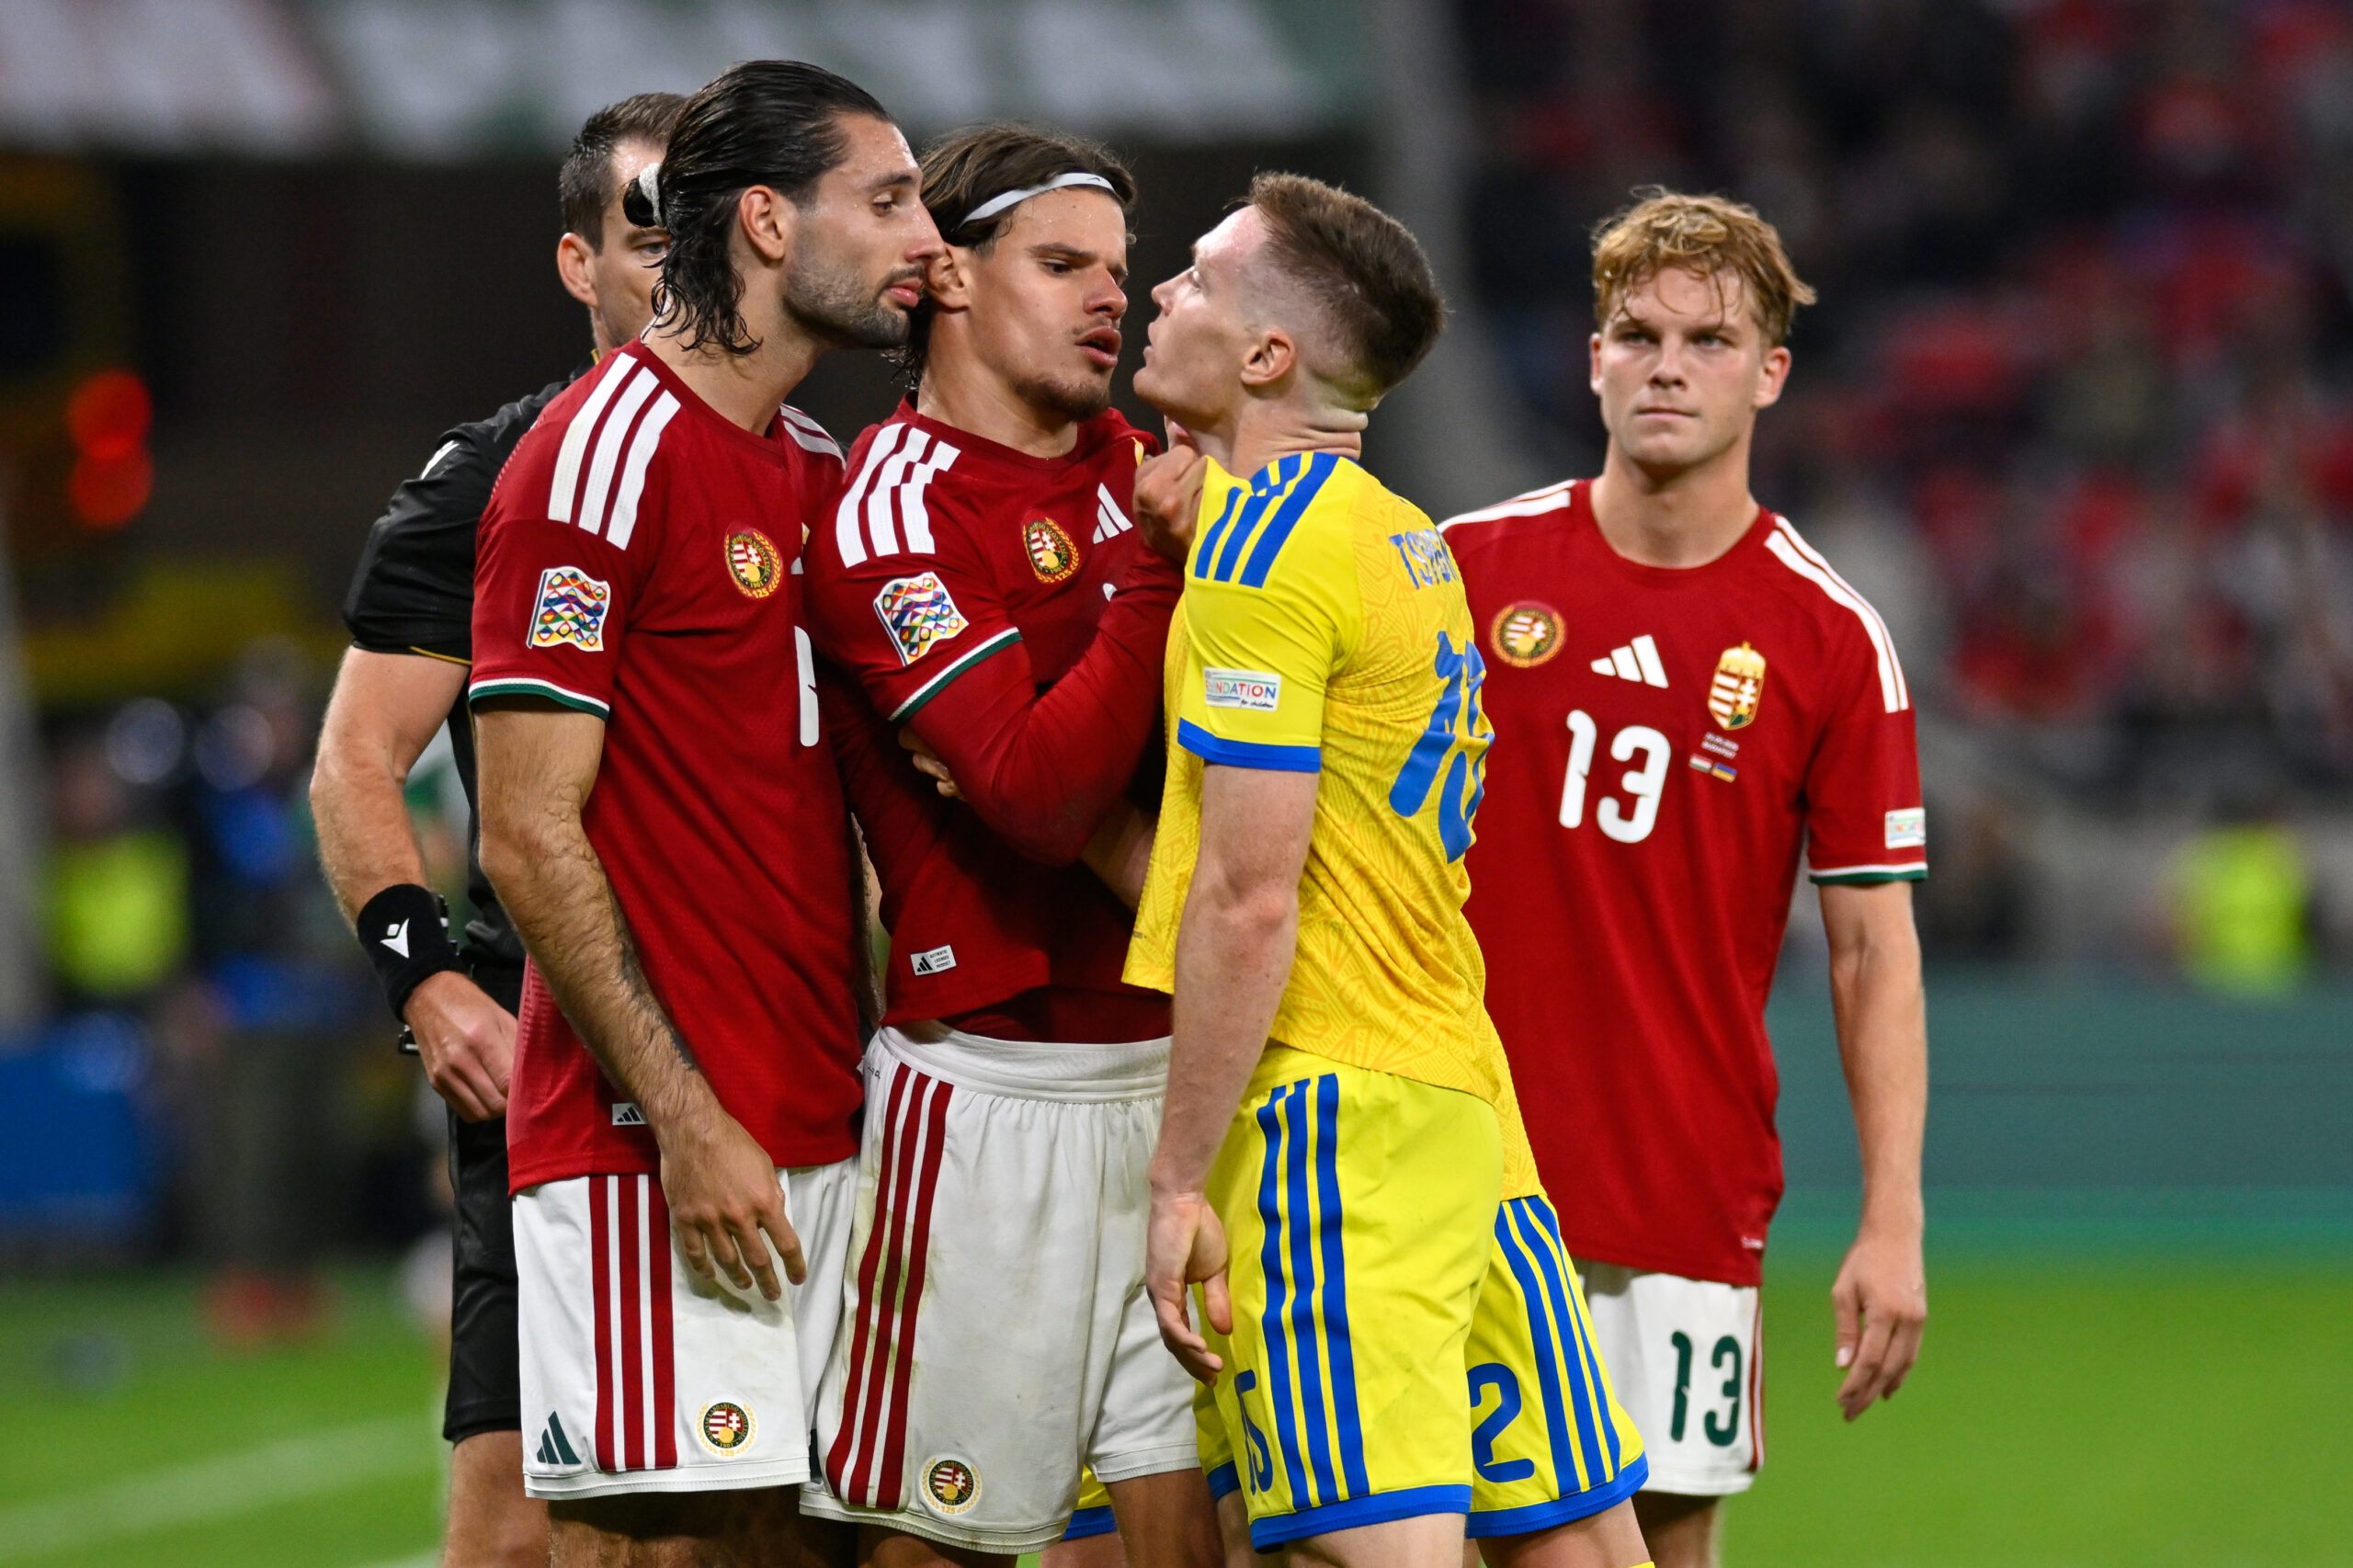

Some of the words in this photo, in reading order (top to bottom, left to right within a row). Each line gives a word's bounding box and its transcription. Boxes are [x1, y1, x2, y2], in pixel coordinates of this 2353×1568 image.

[753, 588, 769, 598] 125
[1559, 709, 1671, 844] 13
[1670, 1330, 1742, 1447] 13
